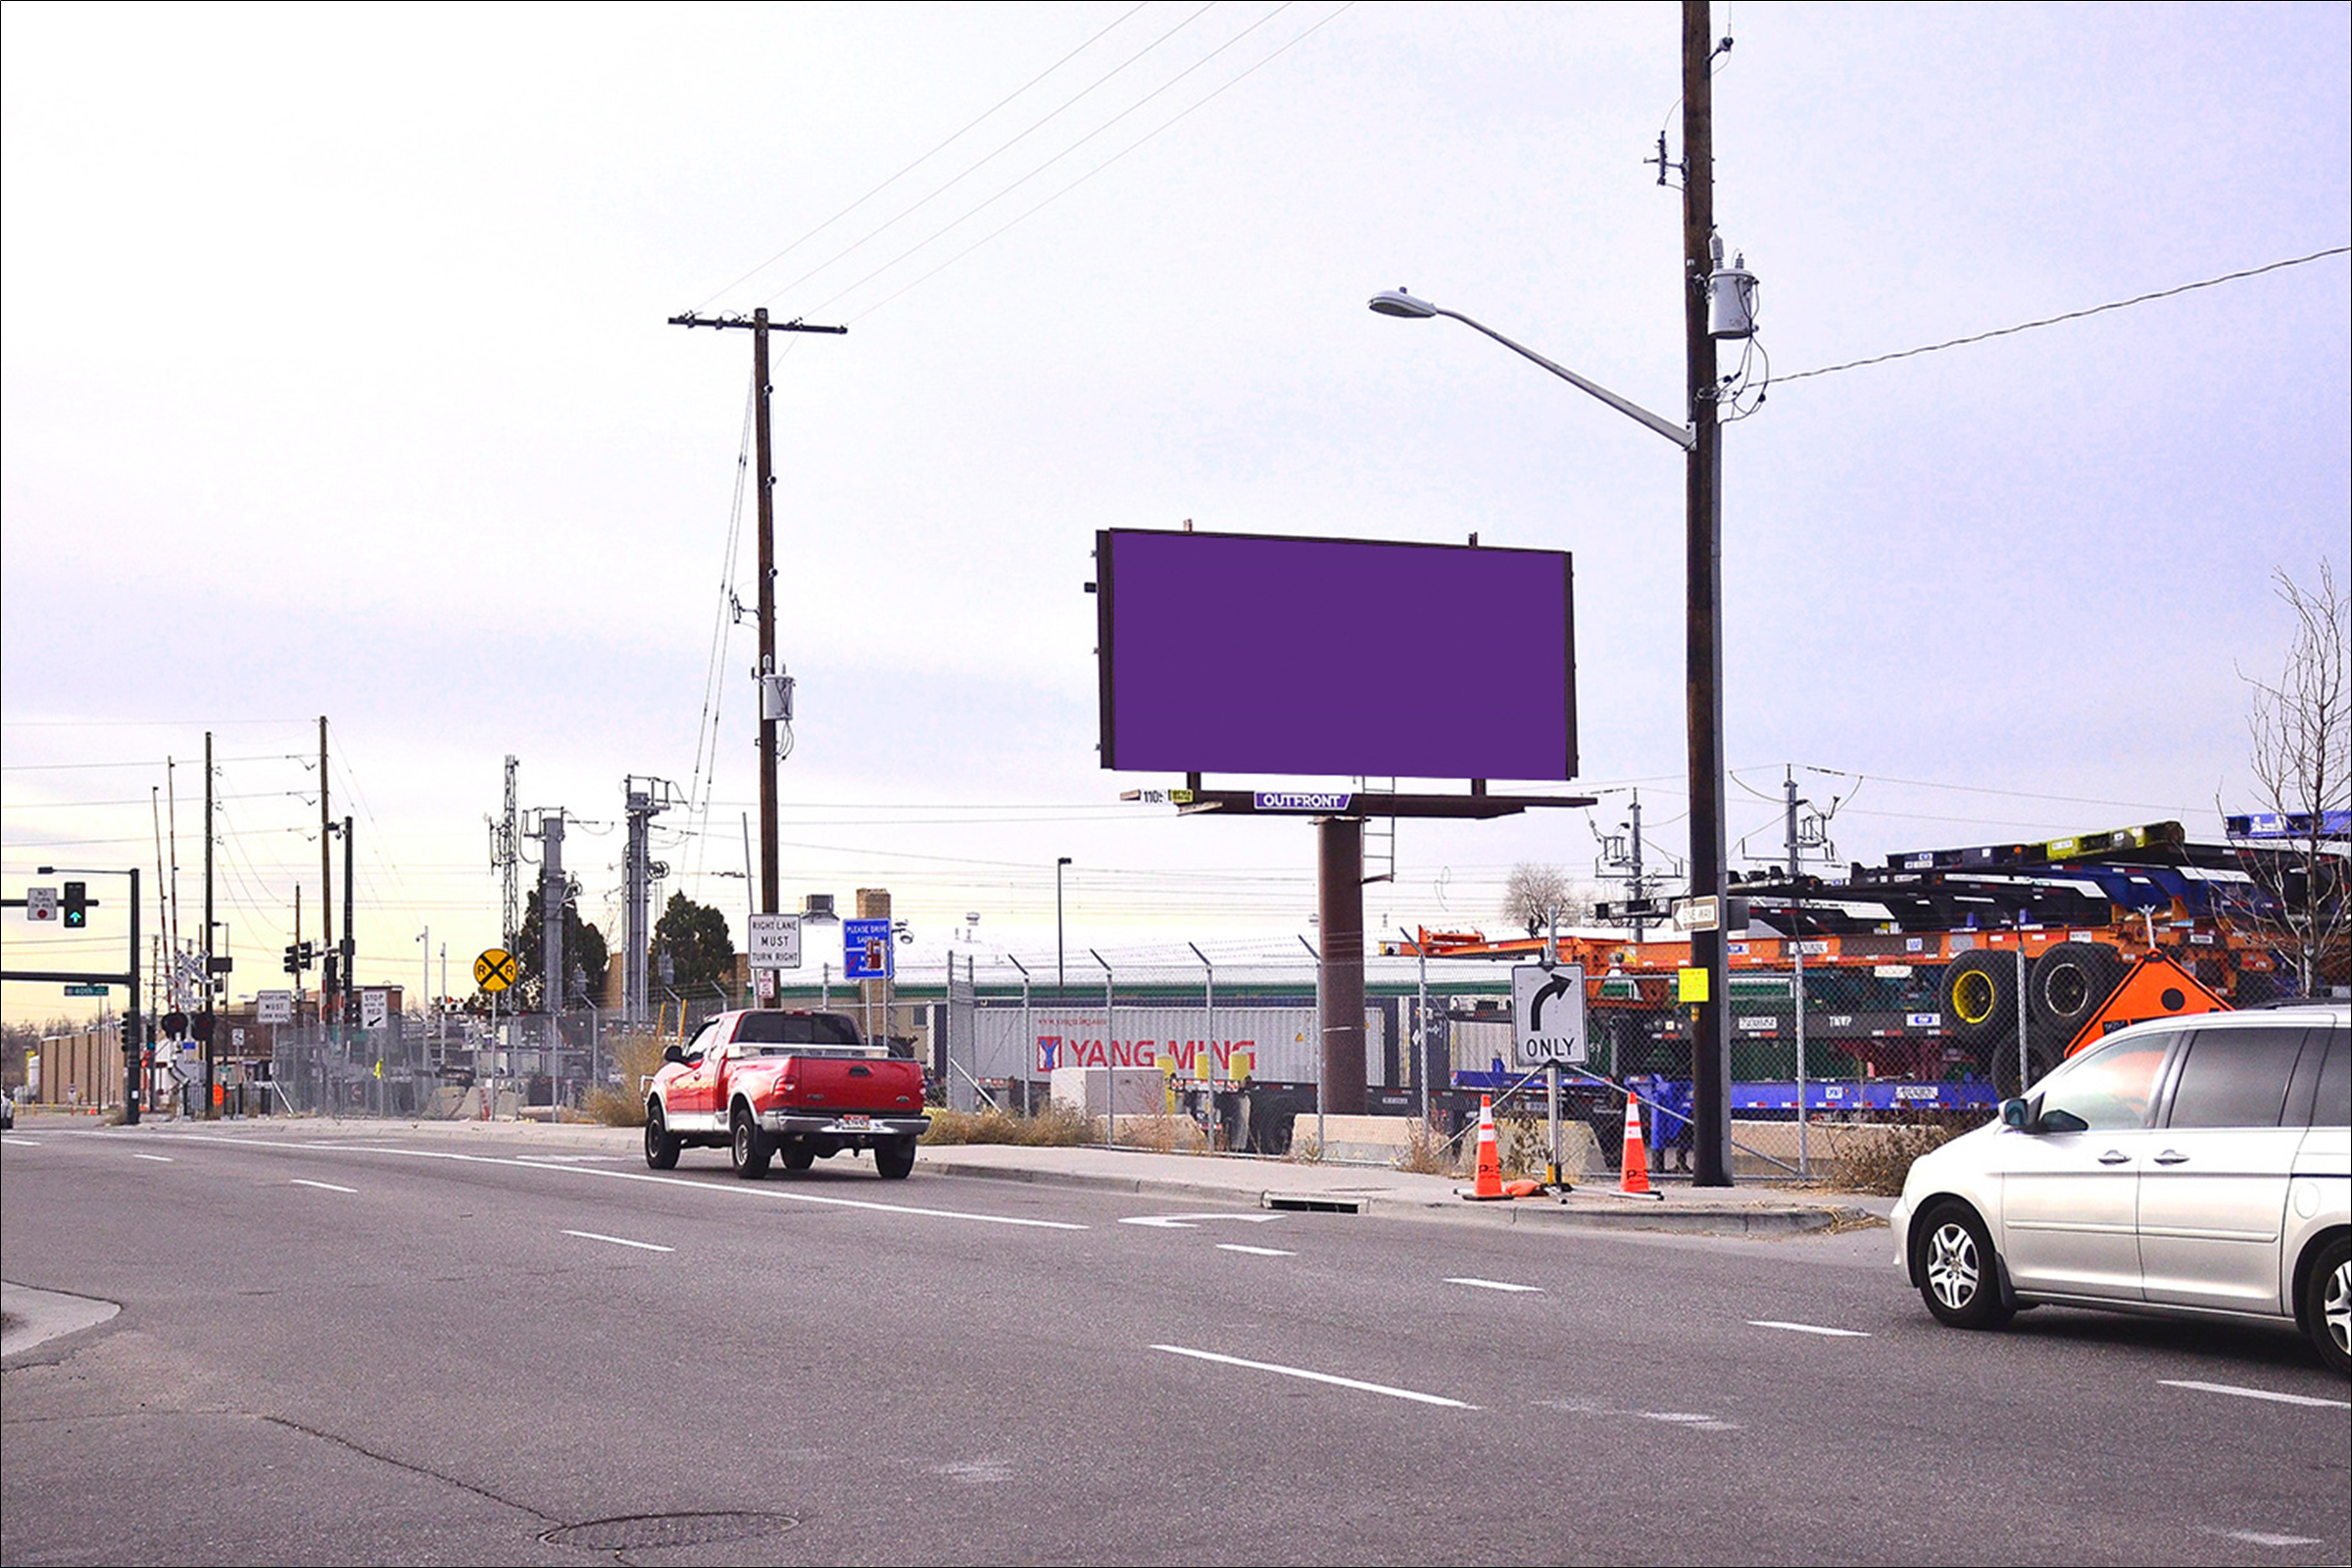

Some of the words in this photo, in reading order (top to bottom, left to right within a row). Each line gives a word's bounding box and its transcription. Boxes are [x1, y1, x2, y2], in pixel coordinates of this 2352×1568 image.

[1263, 794, 1341, 808] OUTFRONT
[753, 921, 774, 931] RIGHT
[776, 921, 797, 931] LANE
[760, 936, 789, 947] MUST
[752, 953, 772, 961] TURN
[775, 953, 798, 961] RIGHT
[477, 964, 486, 976] R
[505, 964, 514, 976] R
[1526, 1038, 1576, 1057] ONLY
[1070, 1040, 1156, 1068] YANG
